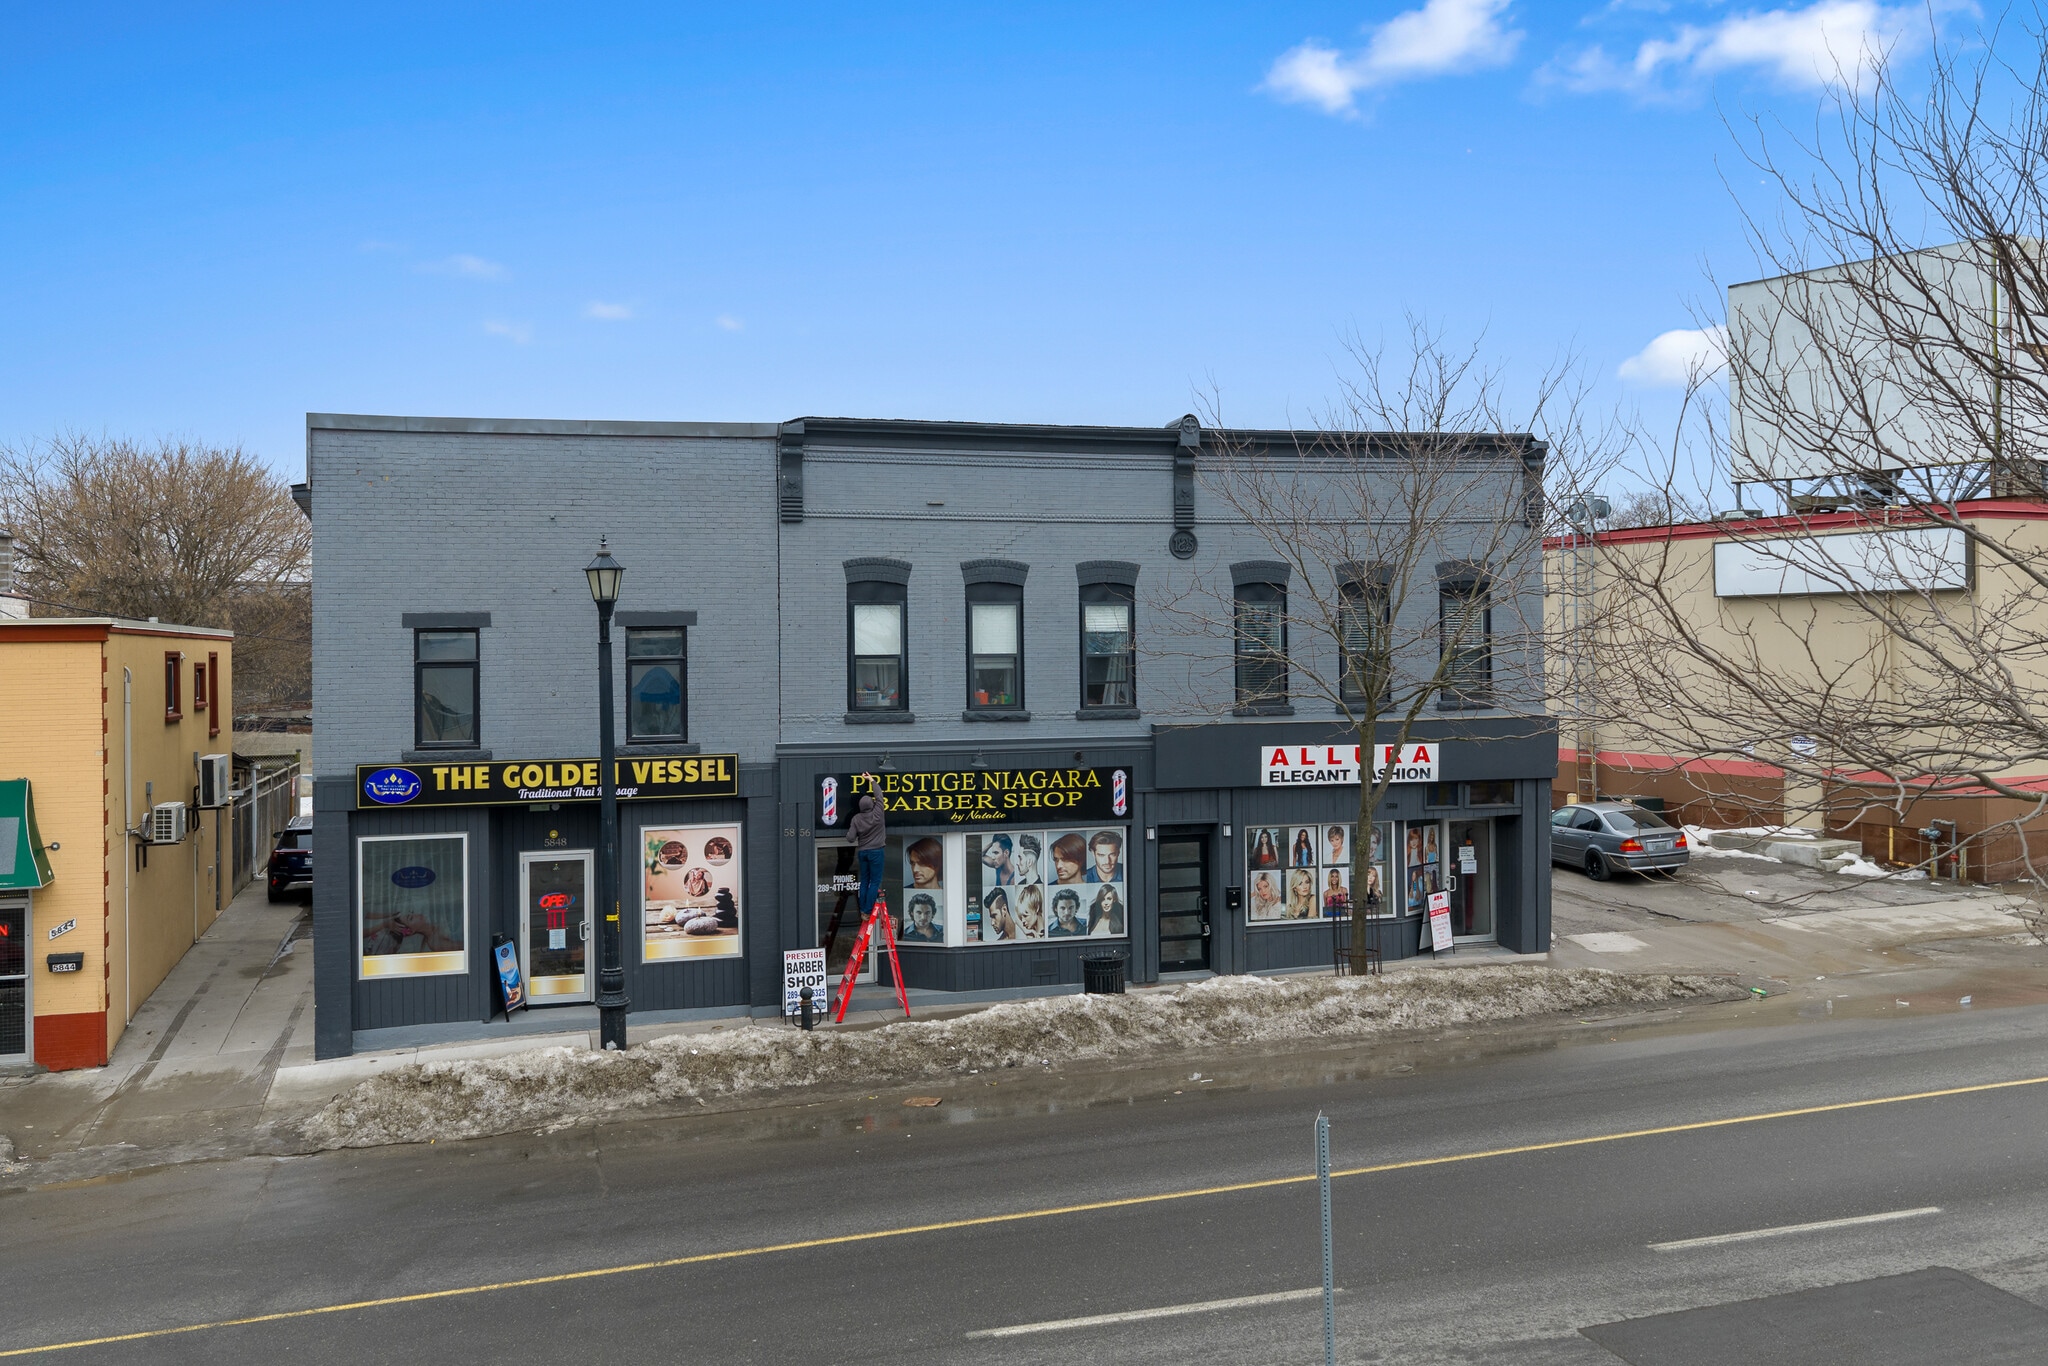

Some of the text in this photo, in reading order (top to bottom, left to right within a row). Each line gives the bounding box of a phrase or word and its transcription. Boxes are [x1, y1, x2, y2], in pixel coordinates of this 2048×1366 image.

[432, 766, 490, 791] THE
[631, 759, 731, 784] VESSEL
[850, 769, 1102, 794] PRESTIGE NIAGARA
[1269, 767, 1431, 783] ELEGANT SHION
[518, 786, 638, 799] Traditional Thai sage
[1003, 791, 1083, 809] SHOP
[950, 810, 1007, 823] by Natalie
[544, 838, 568, 847] 5848
[832, 874, 856, 884] PHONE:
[539, 893, 574, 909] OPEN
[51, 918, 75, 937] 5844
[785, 950, 824, 960] PRESTIGE
[53, 963, 76, 972] 5844
[786, 960, 824, 974] BARBER
[787, 974, 825, 988] SHOP
[787, 988, 826, 999] 289-5325
